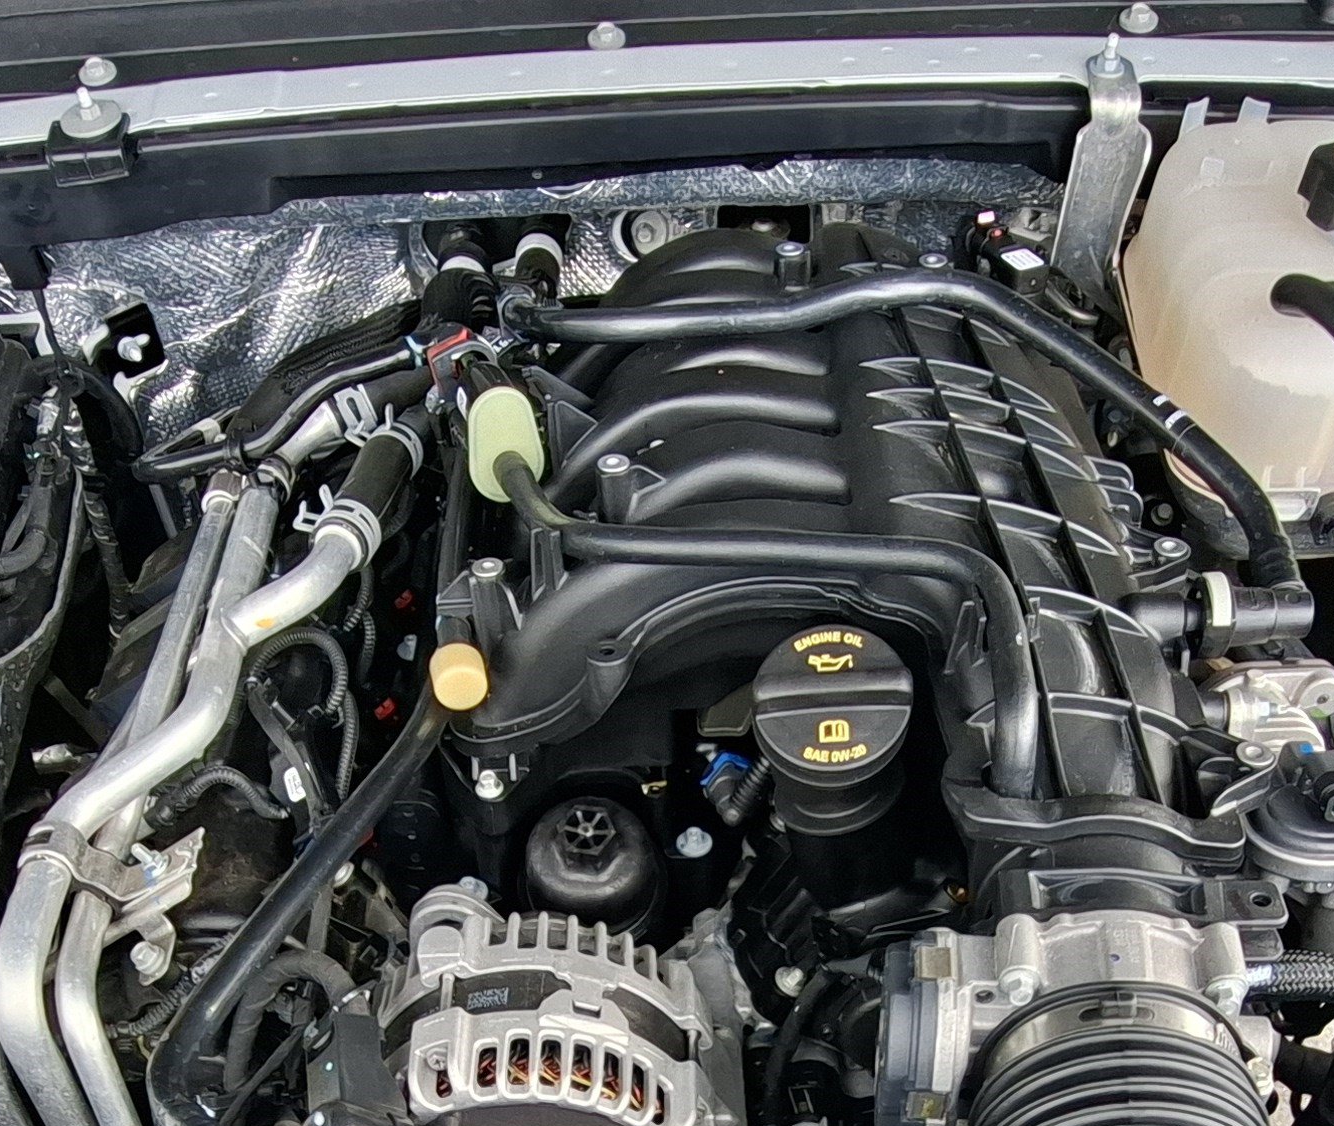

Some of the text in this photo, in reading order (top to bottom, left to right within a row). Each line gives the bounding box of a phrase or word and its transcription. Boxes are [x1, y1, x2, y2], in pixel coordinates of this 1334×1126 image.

[794, 631, 864, 653] ENGINE OIL
[803, 743, 867, 763] SAE 0W-20
